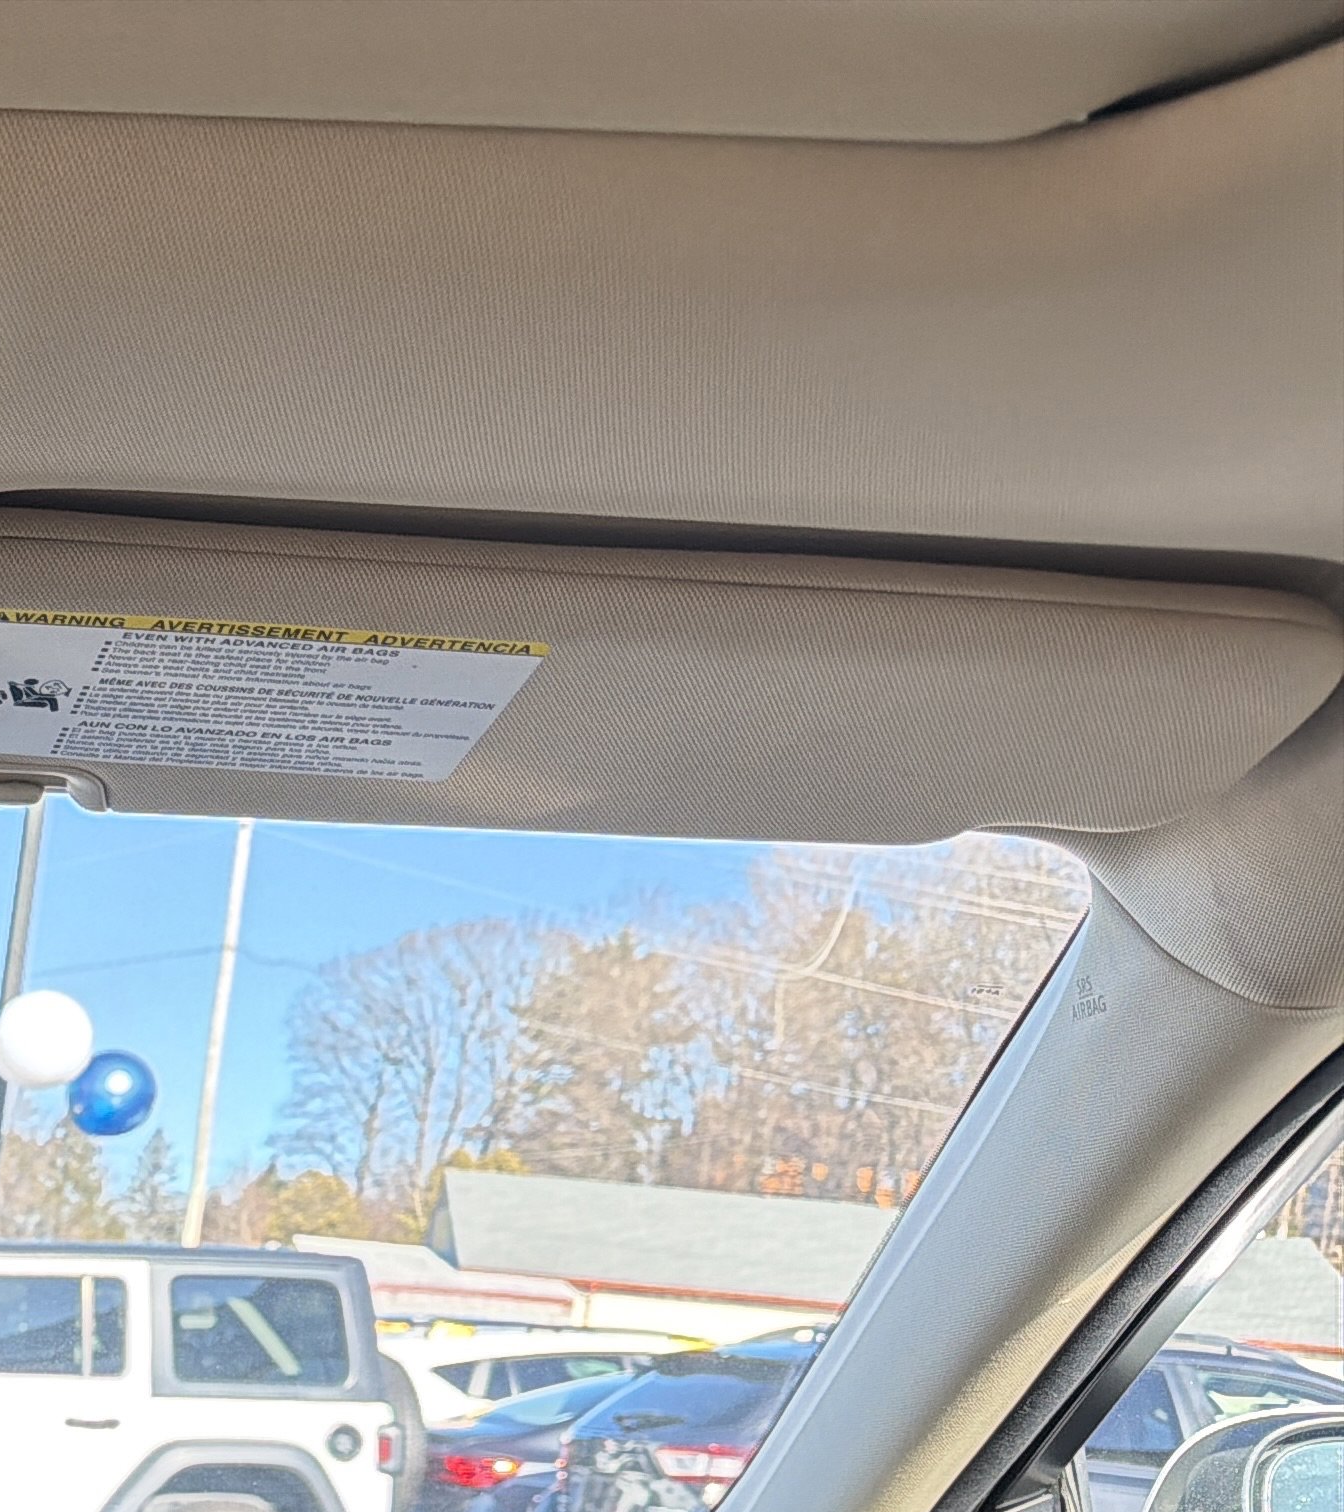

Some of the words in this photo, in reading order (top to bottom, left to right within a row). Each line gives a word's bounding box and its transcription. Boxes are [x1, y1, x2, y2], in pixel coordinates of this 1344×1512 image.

[14, 612, 125, 629] WARNING
[150, 620, 349, 641] AVERTISSEMENT
[361, 634, 531, 656] ADVERTENCIA
[120, 632, 169, 641] EVEN
[172, 635, 216, 644] WITH
[219, 638, 315, 651] ADVANCED
[315, 644, 349, 653] AIR
[350, 647, 402, 656] BAGS
[98, 676, 135, 686] MÊME
[135, 680, 168, 688] AVEC
[168, 682, 194, 690] DES
[194, 684, 256, 694] COUSSINS
[275, 687, 337, 699] SÉCURITÉ
[353, 694, 418, 704] NOUVELLE
[417, 696, 499, 709] GÉNÉRATION
[77, 720, 112, 728] AUN
[113, 722, 148, 730] CON
[174, 726, 258, 737] AVANZADO
[283, 733, 318, 741] LOS
[317, 735, 346, 743] AIR
[347, 737, 394, 746] BAGS
[1076, 976, 1092, 994] SRS
[1072, 995, 1107, 1021] AIRBAG
